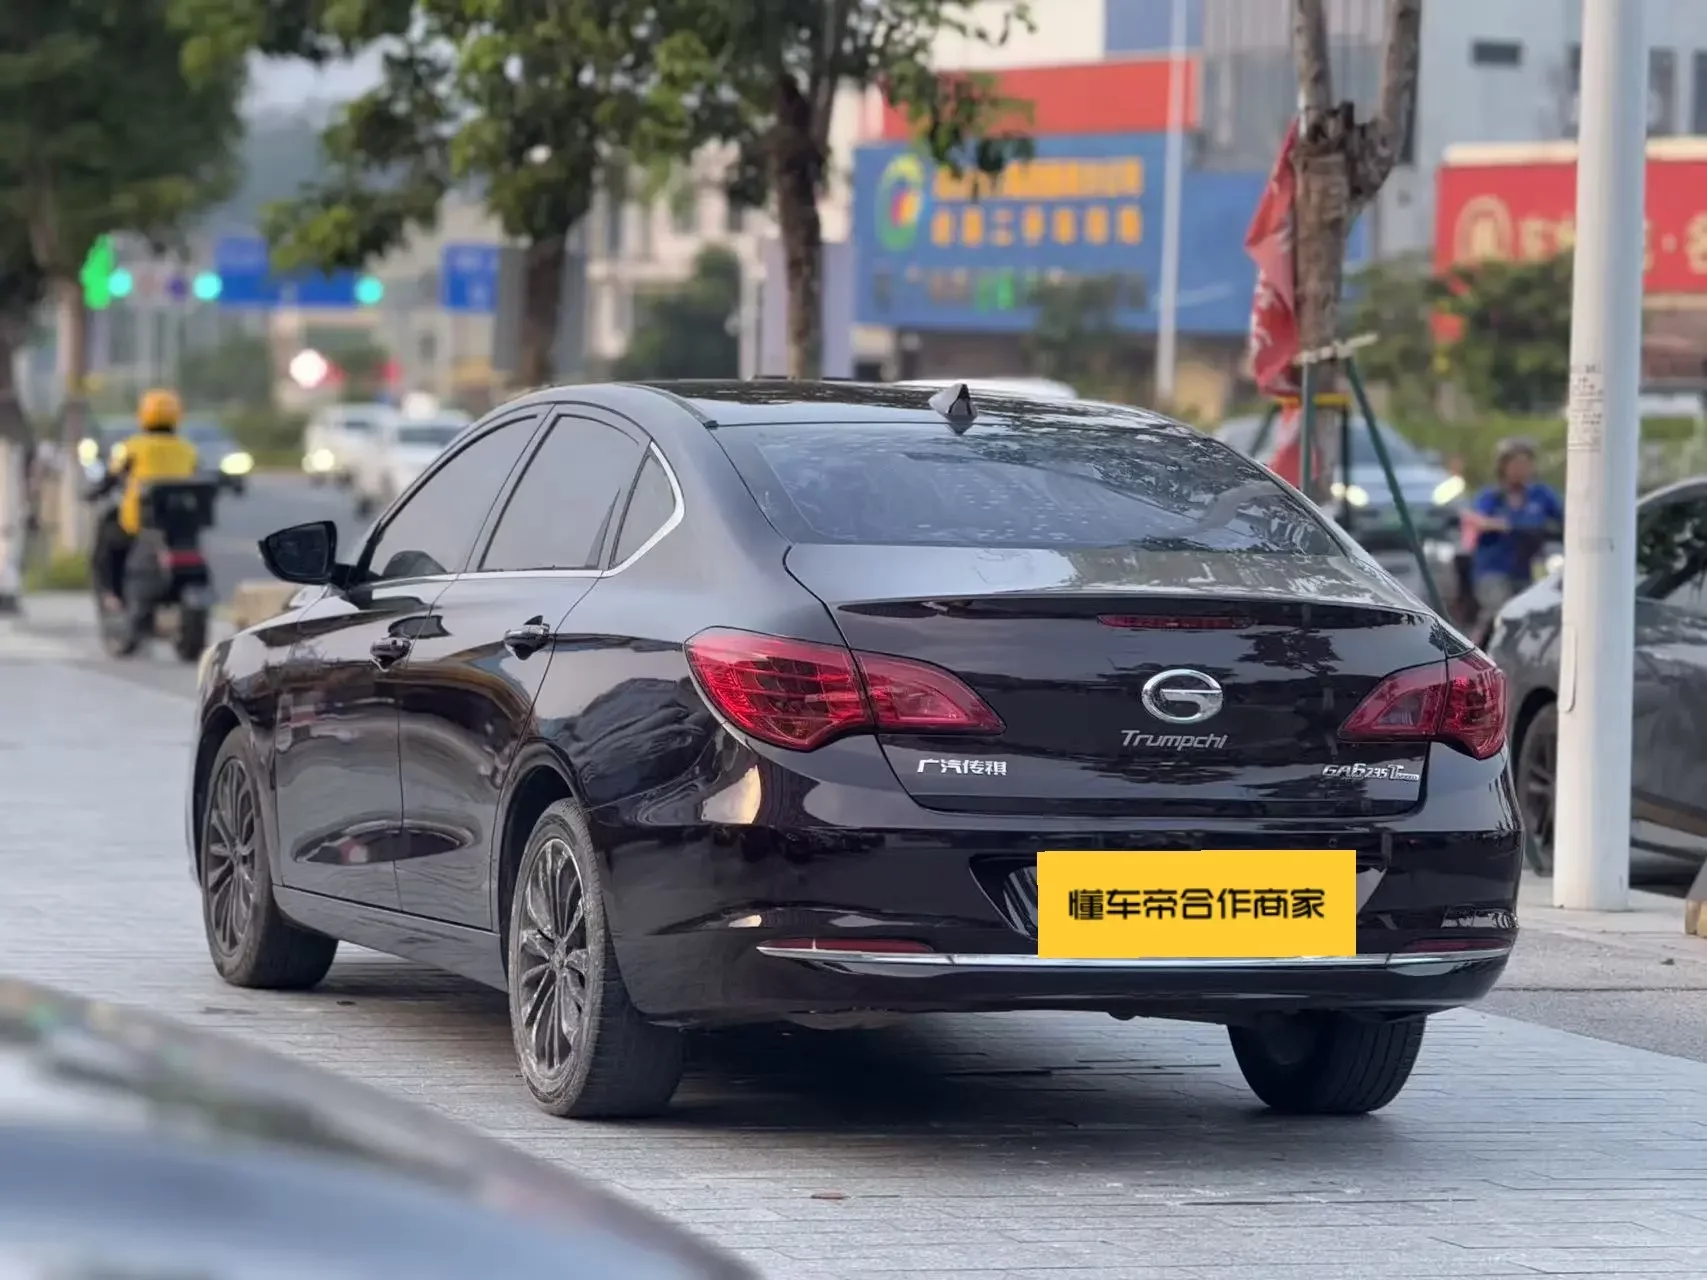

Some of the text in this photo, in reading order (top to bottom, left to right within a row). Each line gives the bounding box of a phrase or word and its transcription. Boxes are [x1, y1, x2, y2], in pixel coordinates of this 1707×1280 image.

[1121, 729, 1228, 751] Trumpchi
[917, 758, 1007, 776] 广汽传祺
